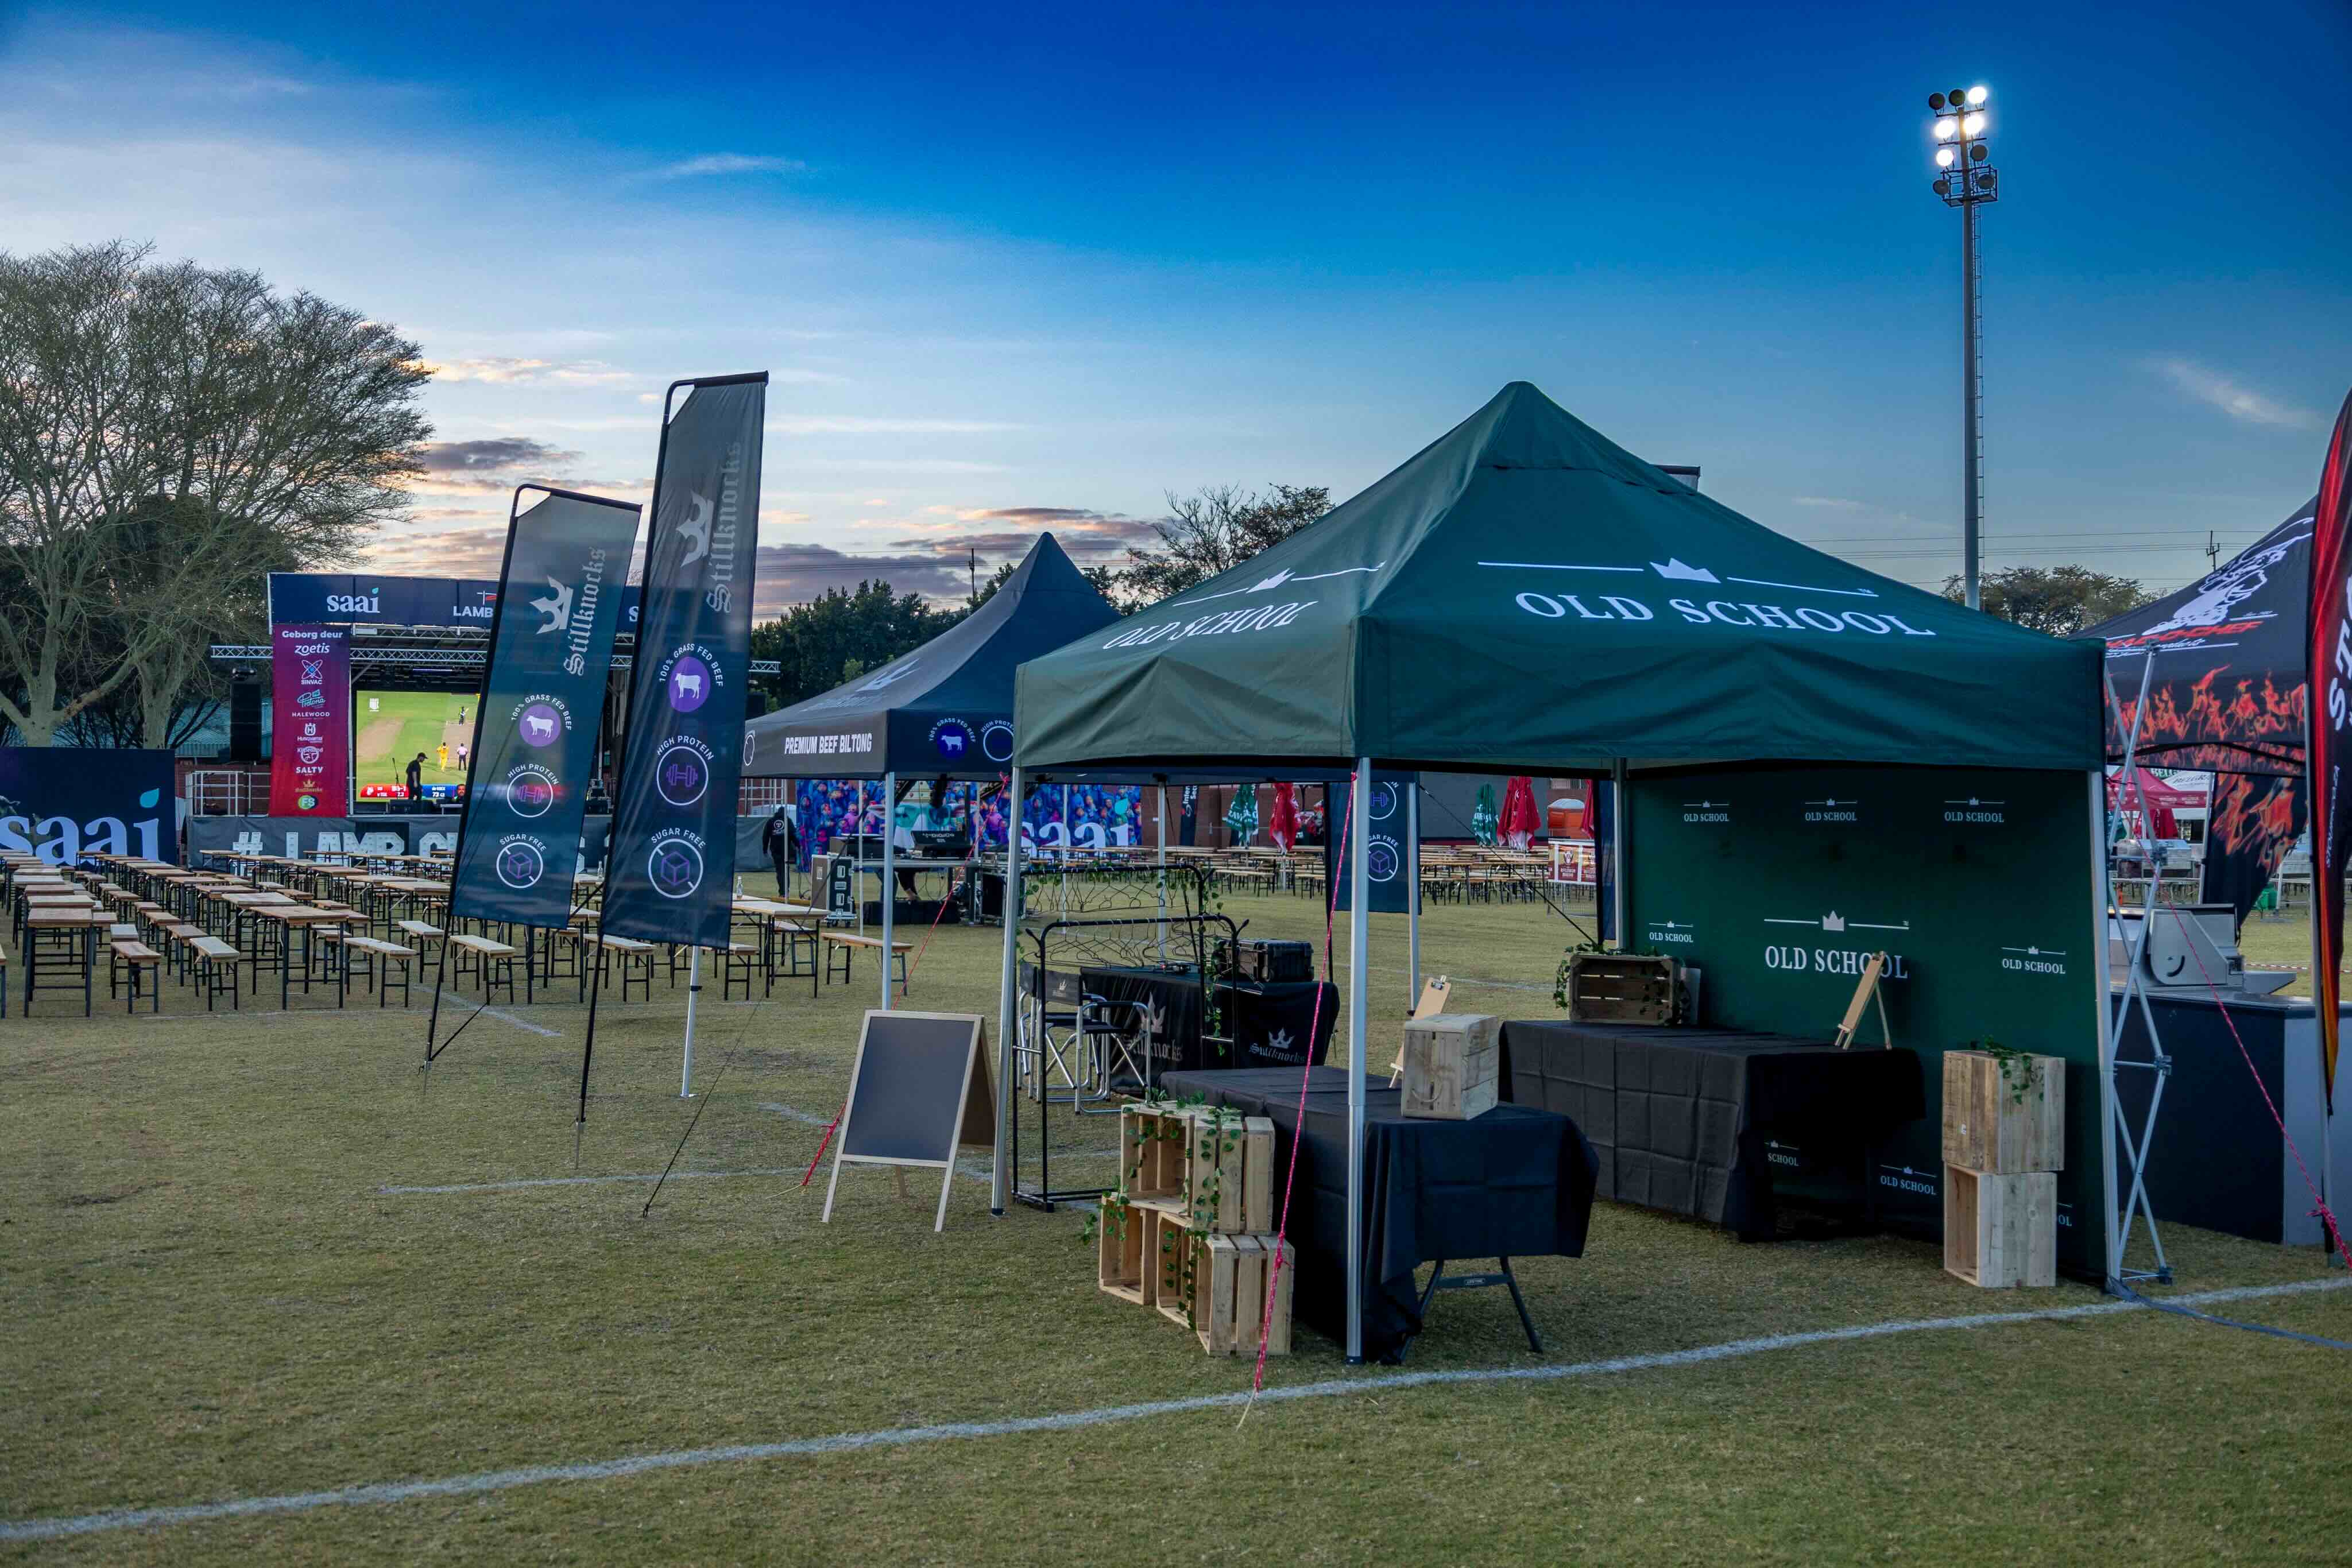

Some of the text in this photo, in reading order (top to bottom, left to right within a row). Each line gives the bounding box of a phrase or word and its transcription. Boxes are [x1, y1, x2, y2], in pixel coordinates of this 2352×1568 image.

[706, 442, 741, 613] Stillknocks
[327, 587, 381, 613] saai
[563, 546, 606, 676] Stillknocks
[1516, 593, 1937, 636] OLD SCHOOL
[282, 630, 343, 639] Geborg deur
[1102, 601, 1319, 649] OLD SCHOOL
[295, 642, 330, 656] zoetis
[659, 643, 724, 688] 100% GRASS FED BEEF
[525, 694, 551, 704] GRASS
[551, 697, 566, 710] FED
[562, 710, 572, 731] BEEF
[937, 718, 956, 726] GRASS
[980, 721, 995, 733] HIGH
[656, 735, 714, 761] HIGH PROTEIN
[784, 733, 873, 754] PREMIUM BEEF BILTONG
[507, 763, 560, 786] HIGH PROTEIN
[1684, 814, 1730, 822] OLD SCHOOL
[1805, 812, 1857, 821] OLD SCHOOL
[1944, 811, 2004, 823] OLD SCHOOL
[0, 788, 167, 866] saai
[500, 834, 547, 852] SUGAR FREE
[651, 827, 706, 849] SUGAR FREE
[1383, 835, 1398, 847] FREE
[1649, 932, 1693, 943] OLD SCHOOL
[1765, 946, 1807, 970] OLD
[2002, 958, 2066, 974] OLD SCHOOL
[1767, 1152, 1799, 1167] SCHOOL
[1880, 1175, 1936, 1195] OLD SCHOOL
